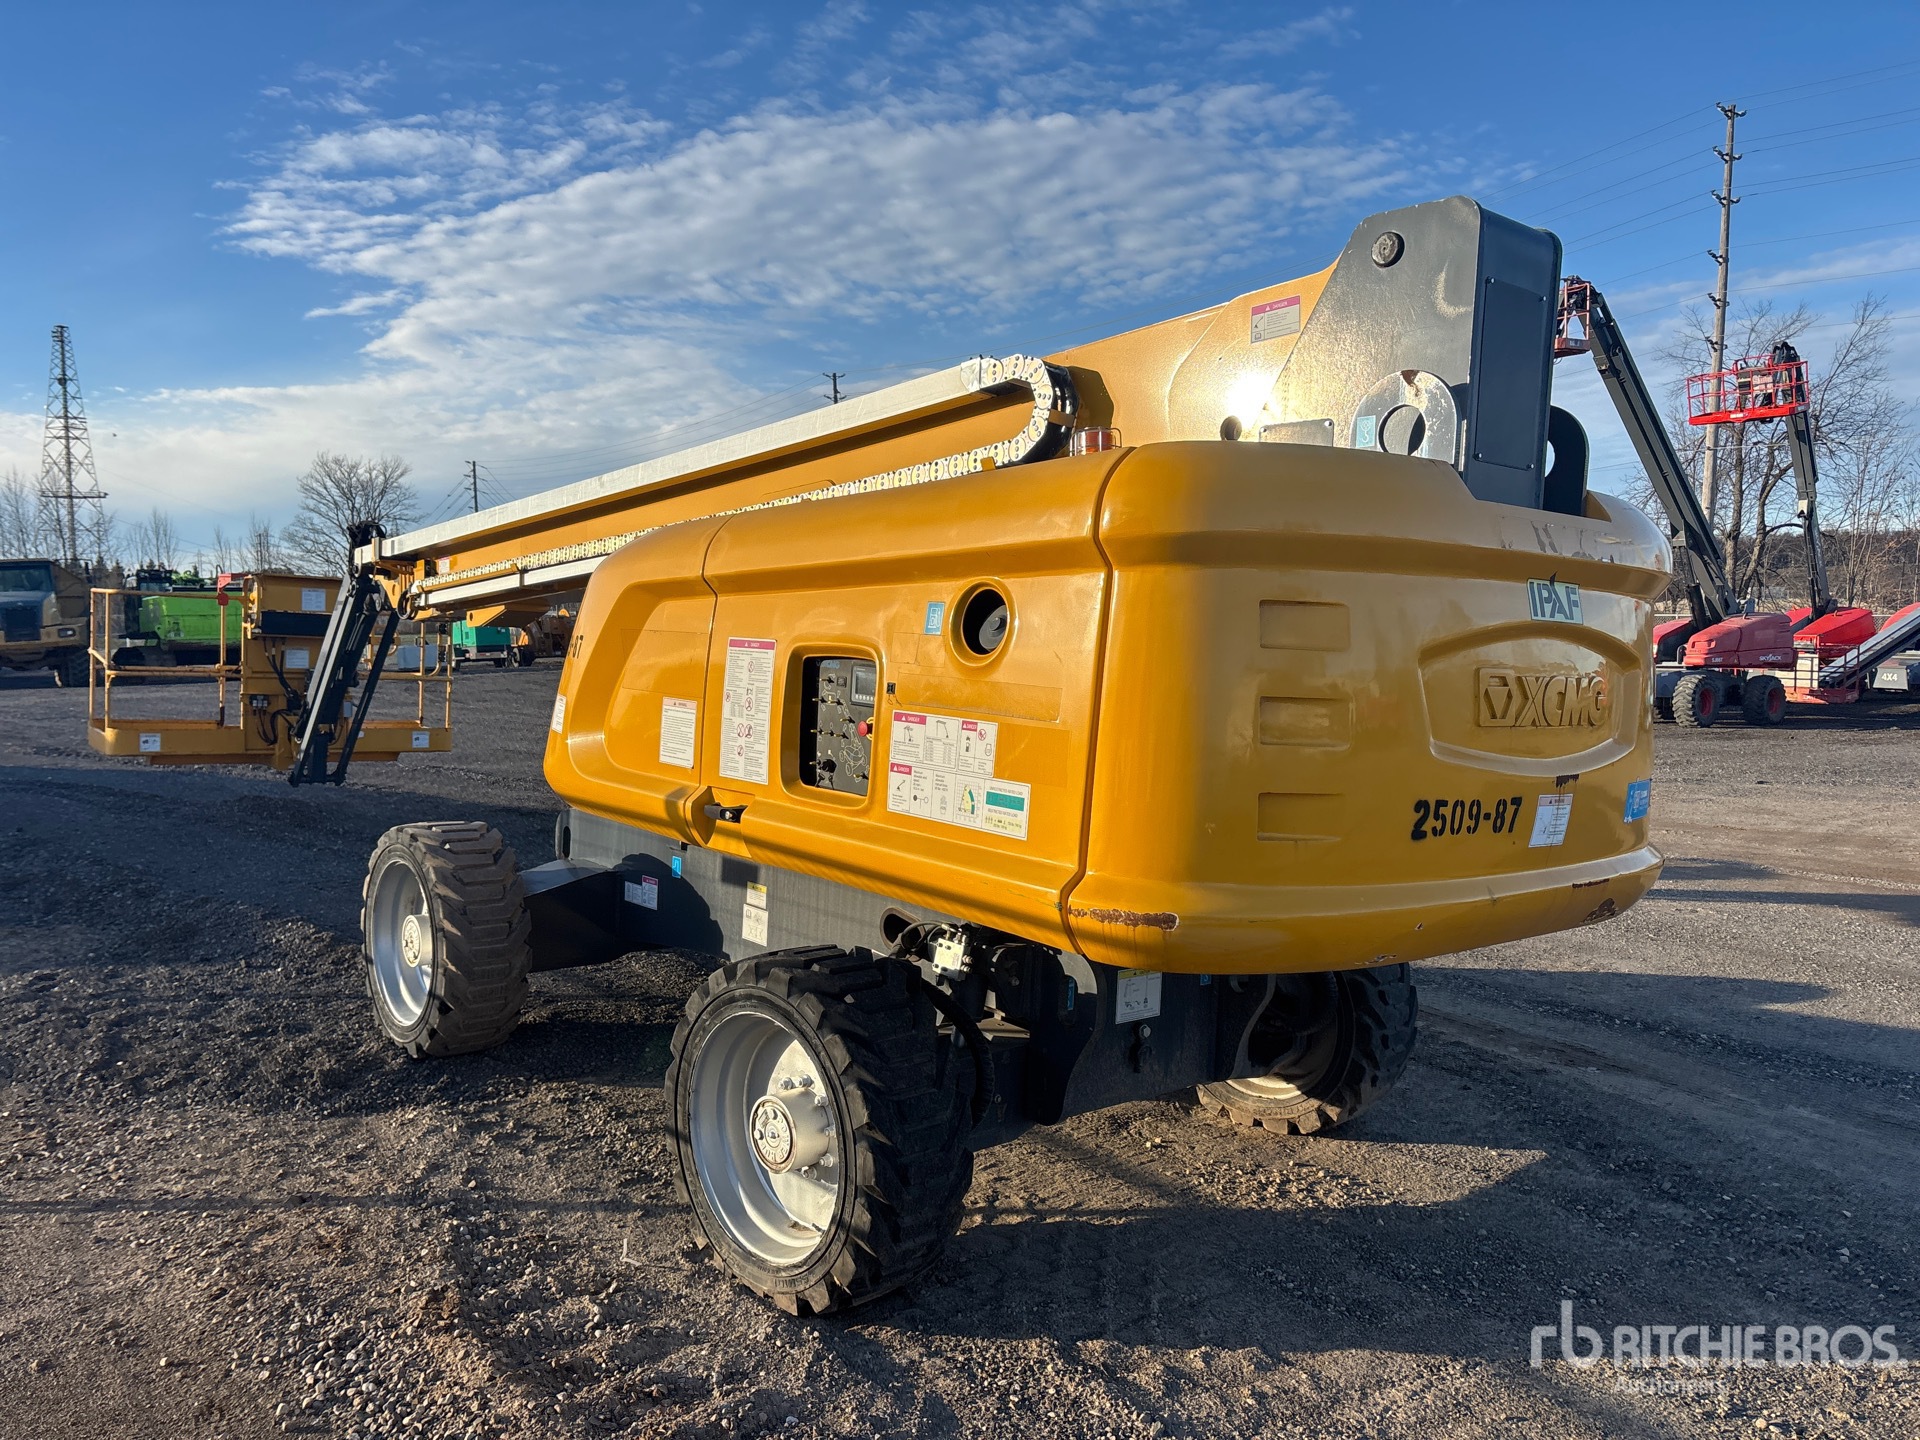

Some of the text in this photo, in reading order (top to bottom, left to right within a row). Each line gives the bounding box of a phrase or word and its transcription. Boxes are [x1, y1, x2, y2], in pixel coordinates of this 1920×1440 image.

[1529, 581, 1579, 621] IPAF
[1759, 654, 1782, 662] SKYJACK
[1881, 672, 1898, 682] 4X4
[1515, 675, 1607, 727] XCMG
[1411, 796, 1522, 840] 2509-87
